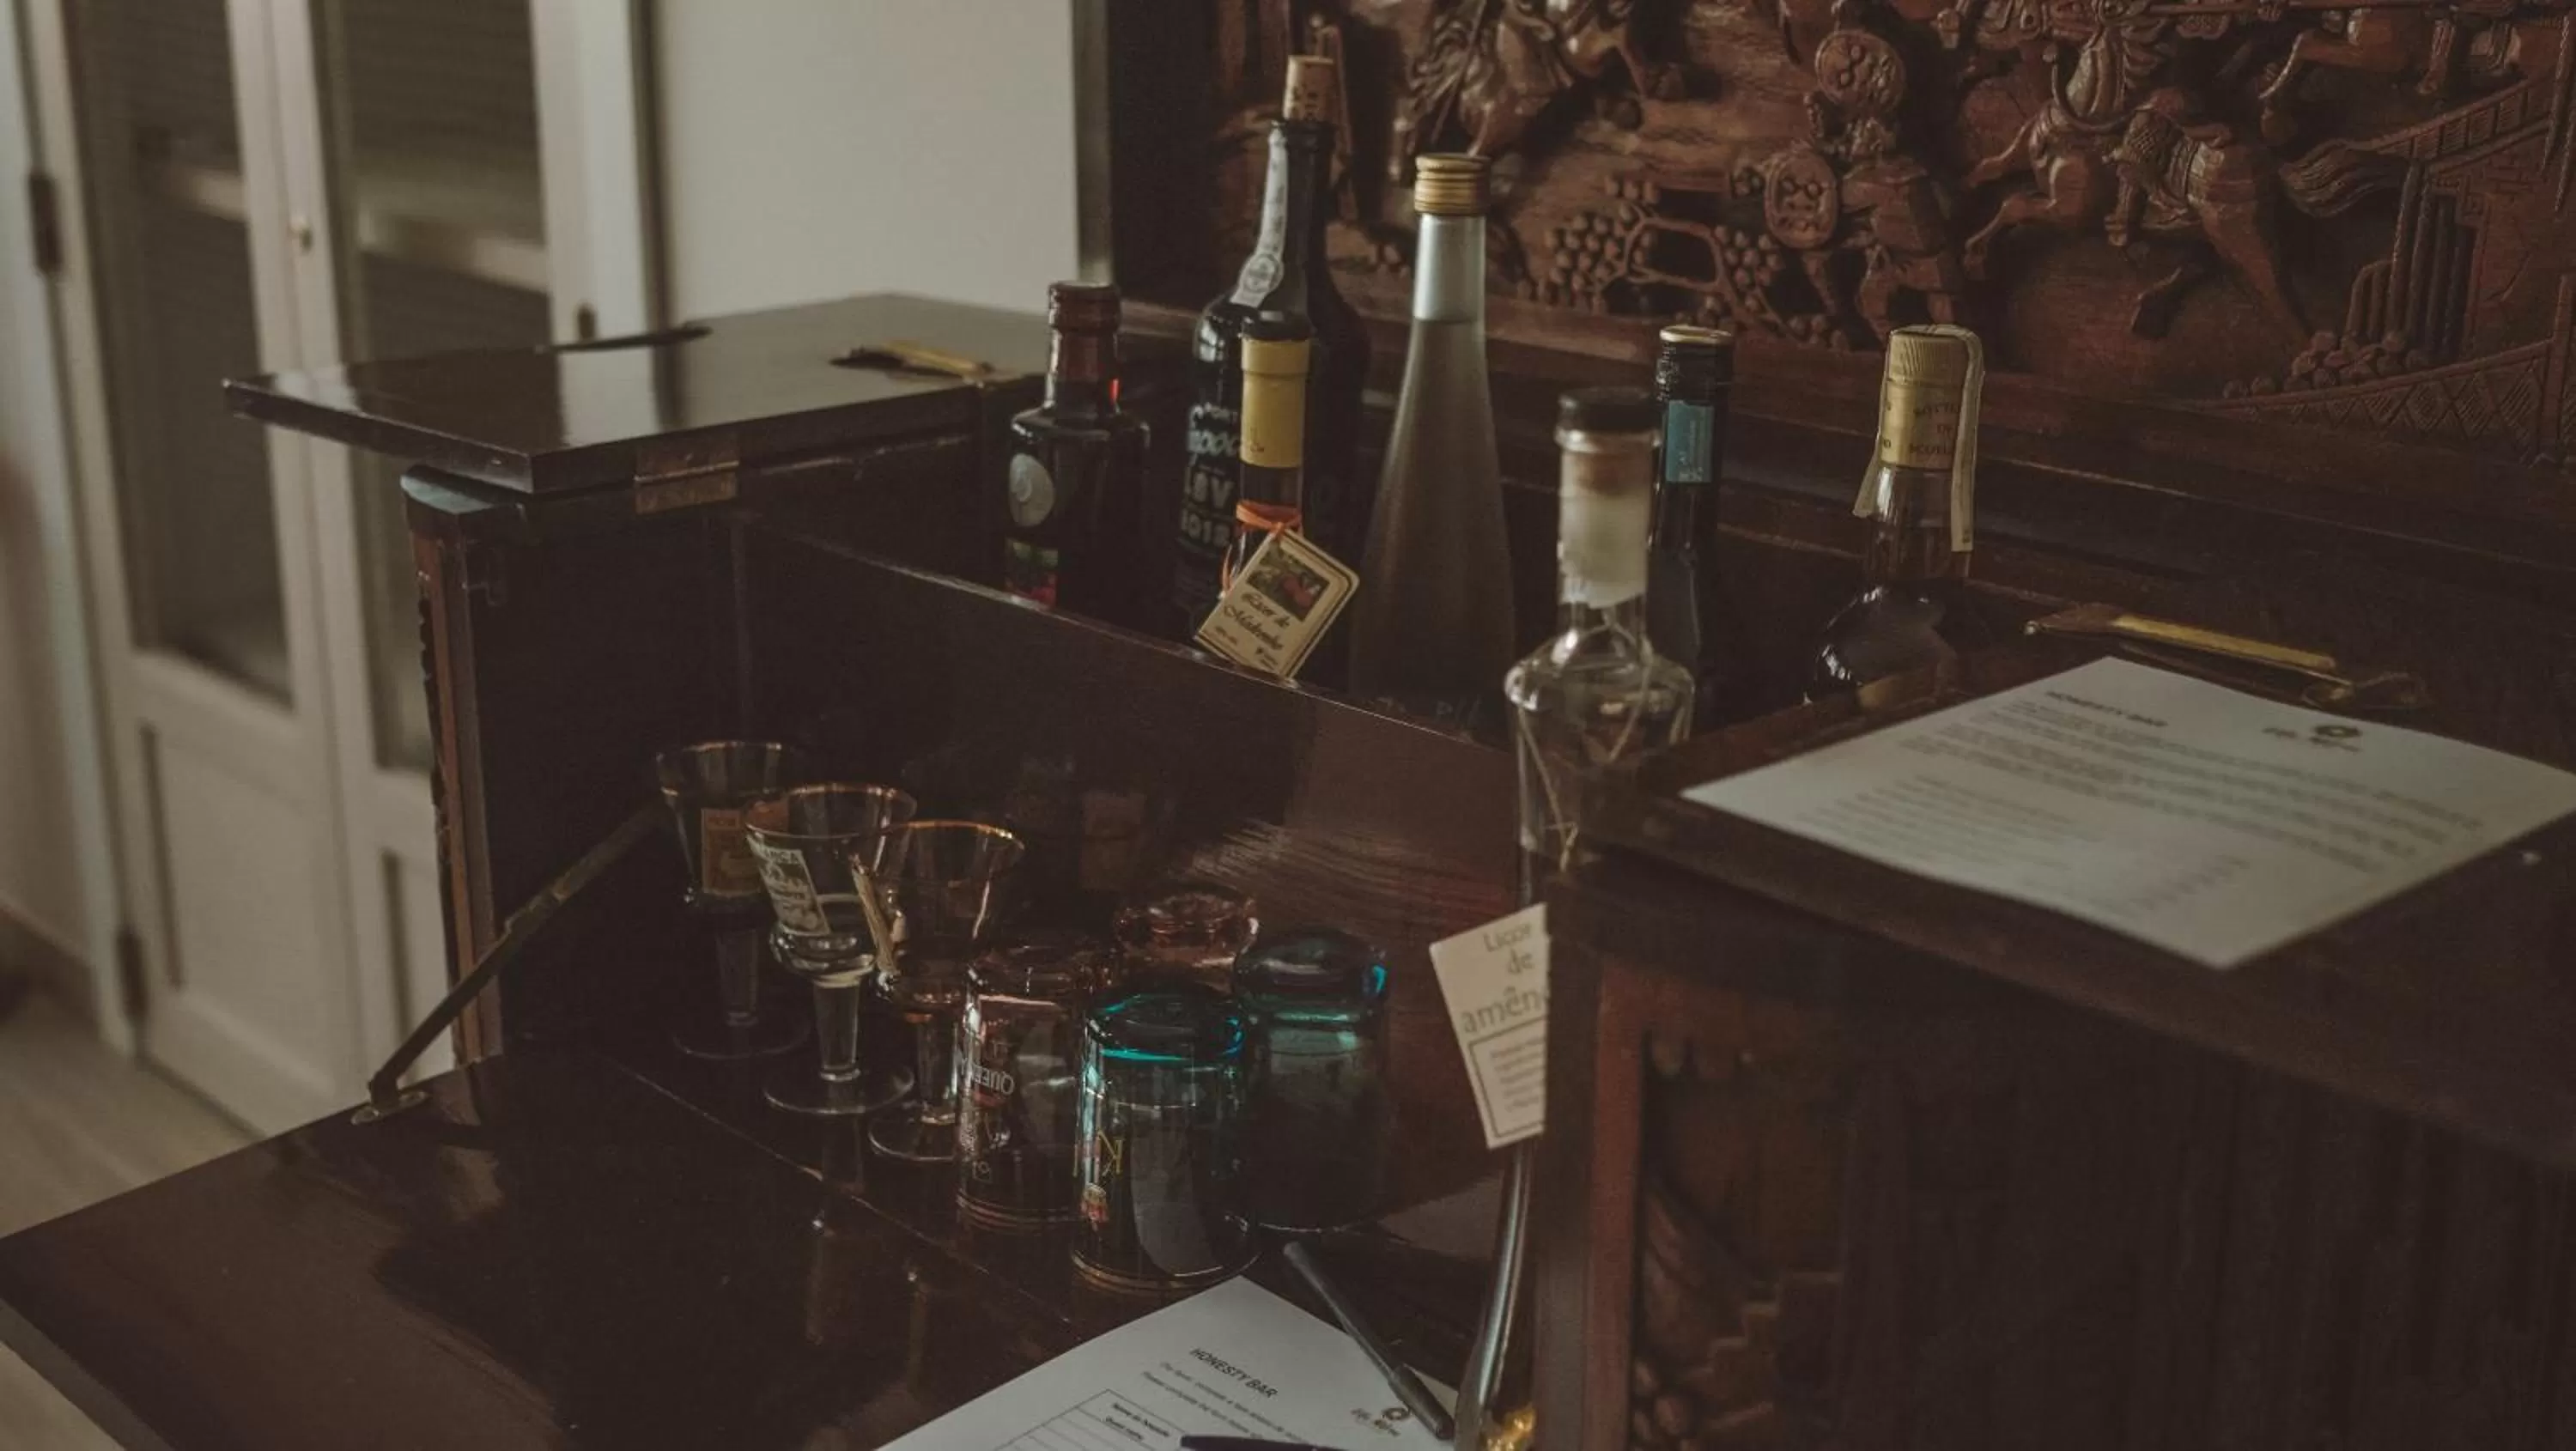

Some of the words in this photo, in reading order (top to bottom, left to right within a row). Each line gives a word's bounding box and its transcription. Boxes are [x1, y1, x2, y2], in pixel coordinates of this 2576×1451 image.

[1483, 921, 1532, 953] Licor
[1507, 948, 1536, 975] de
[1462, 987, 1545, 1034] amên
[1245, 1379, 1279, 1399] BAR
